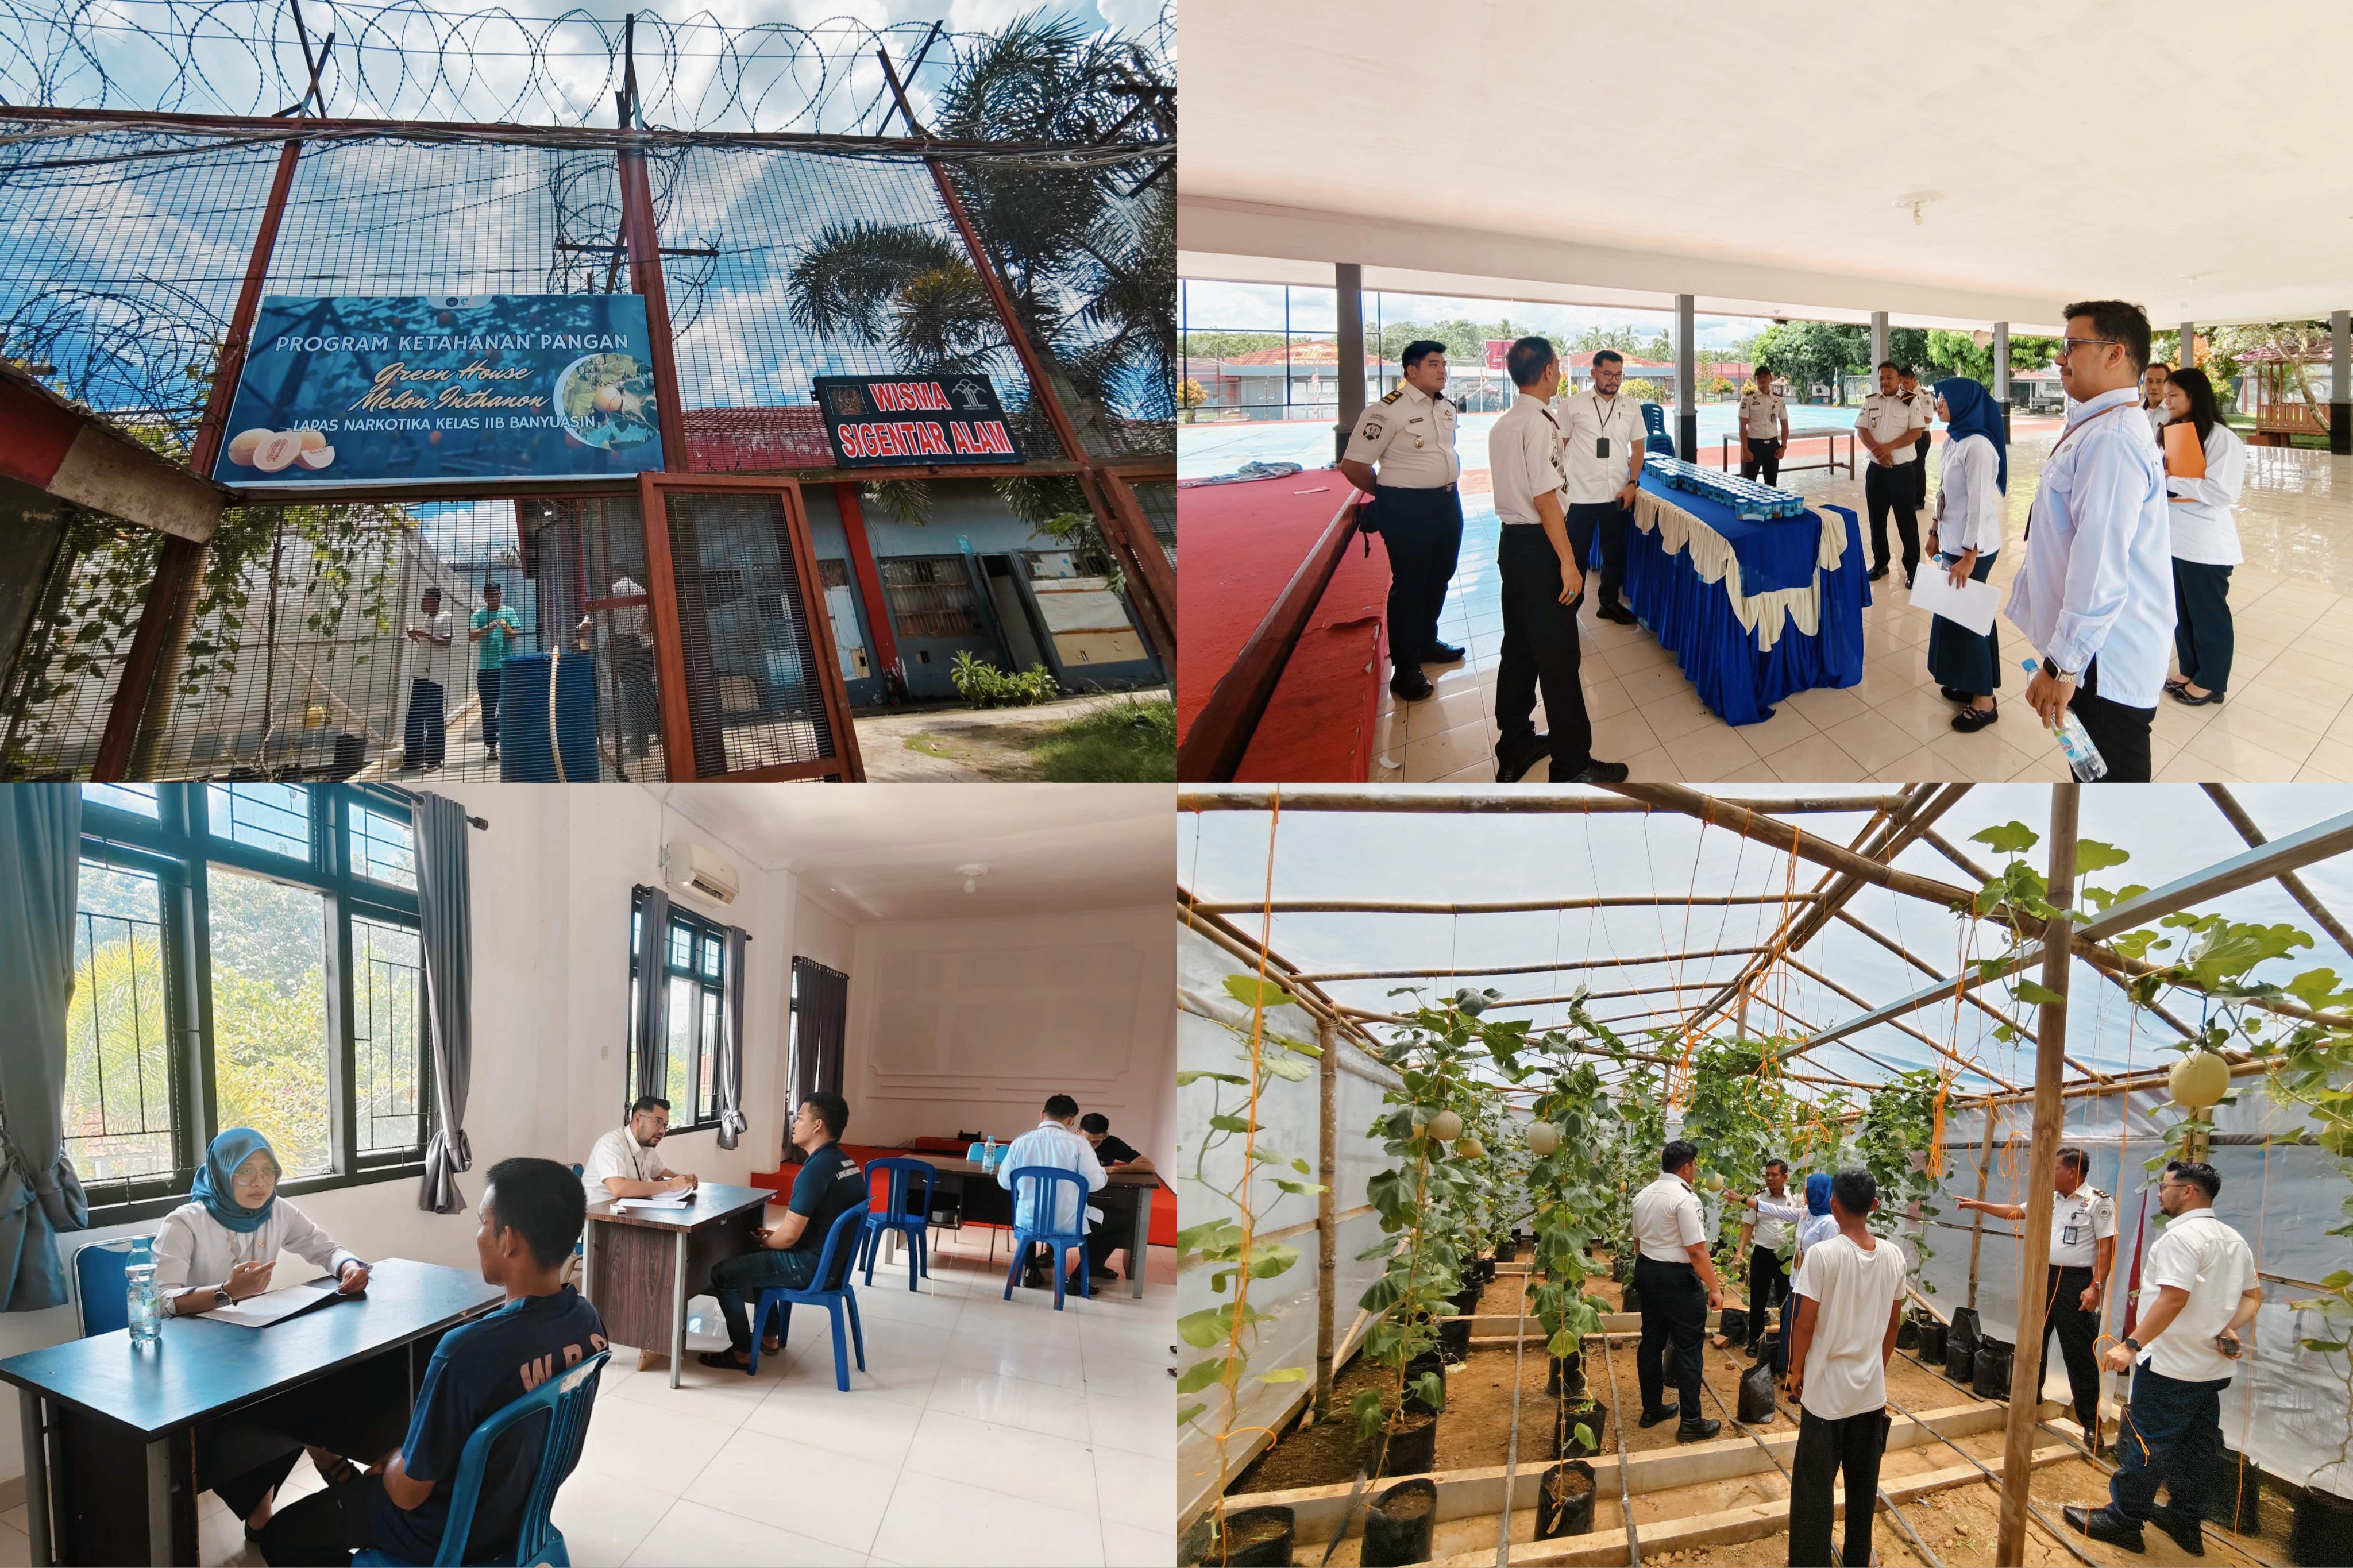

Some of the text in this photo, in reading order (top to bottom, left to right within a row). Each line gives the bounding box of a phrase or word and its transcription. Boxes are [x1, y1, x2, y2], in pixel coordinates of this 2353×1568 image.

[275, 333, 629, 352] PROGRAM KETAHANAN PANGAN
[368, 358, 534, 393] Green House
[346, 385, 551, 413] Melon Inthanon
[868, 381, 952, 412] WISMA
[292, 415, 596, 432] LAPAS NARKOTIKA KELAS IIB BANYUASIN
[838, 420, 1015, 458] SIGENTAR ALAM
